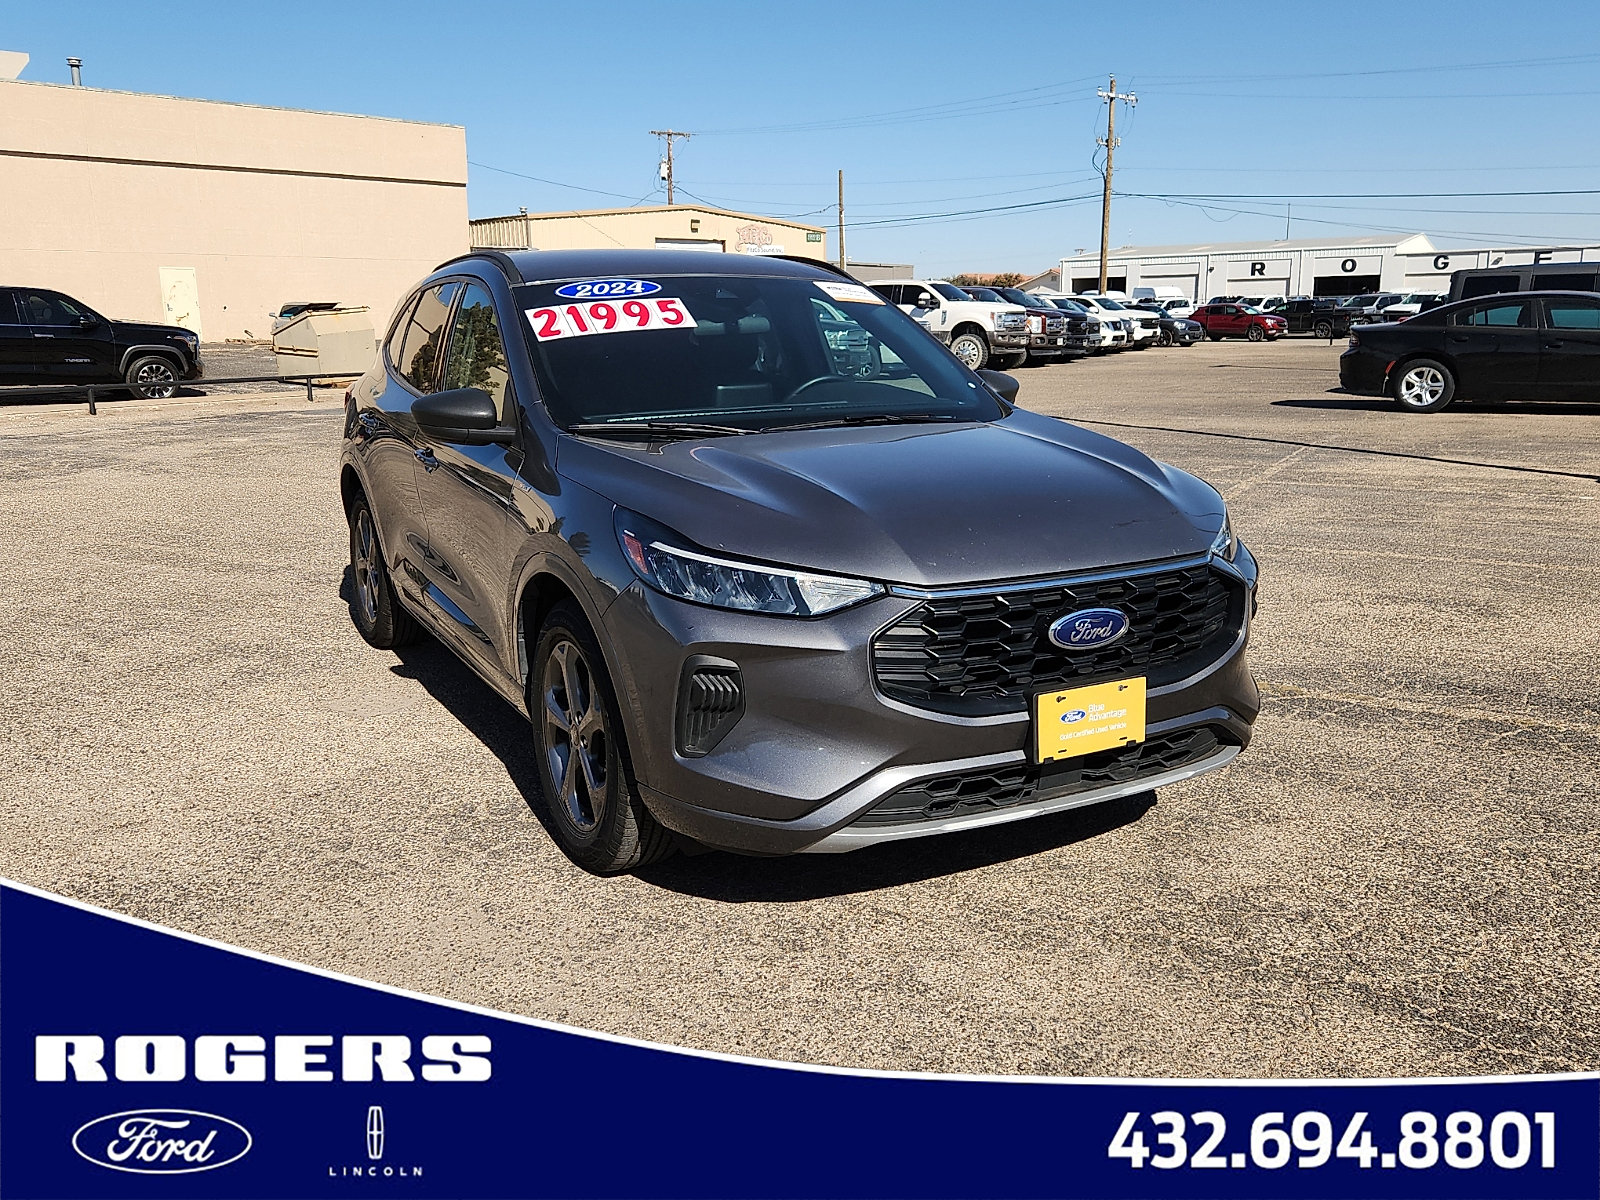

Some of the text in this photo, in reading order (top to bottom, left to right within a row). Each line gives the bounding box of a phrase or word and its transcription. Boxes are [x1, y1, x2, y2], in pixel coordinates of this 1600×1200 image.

[1250, 261, 1266, 277] R
[1341, 258, 1357, 273] O
[1433, 254, 1449, 270] G
[575, 280, 646, 298] 2024
[533, 300, 684, 338] 21995
[1070, 617, 1113, 643] Ford
[1065, 710, 1084, 722] Ford
[1088, 703, 1105, 713] Blue
[1088, 708, 1127, 722] Advantage
